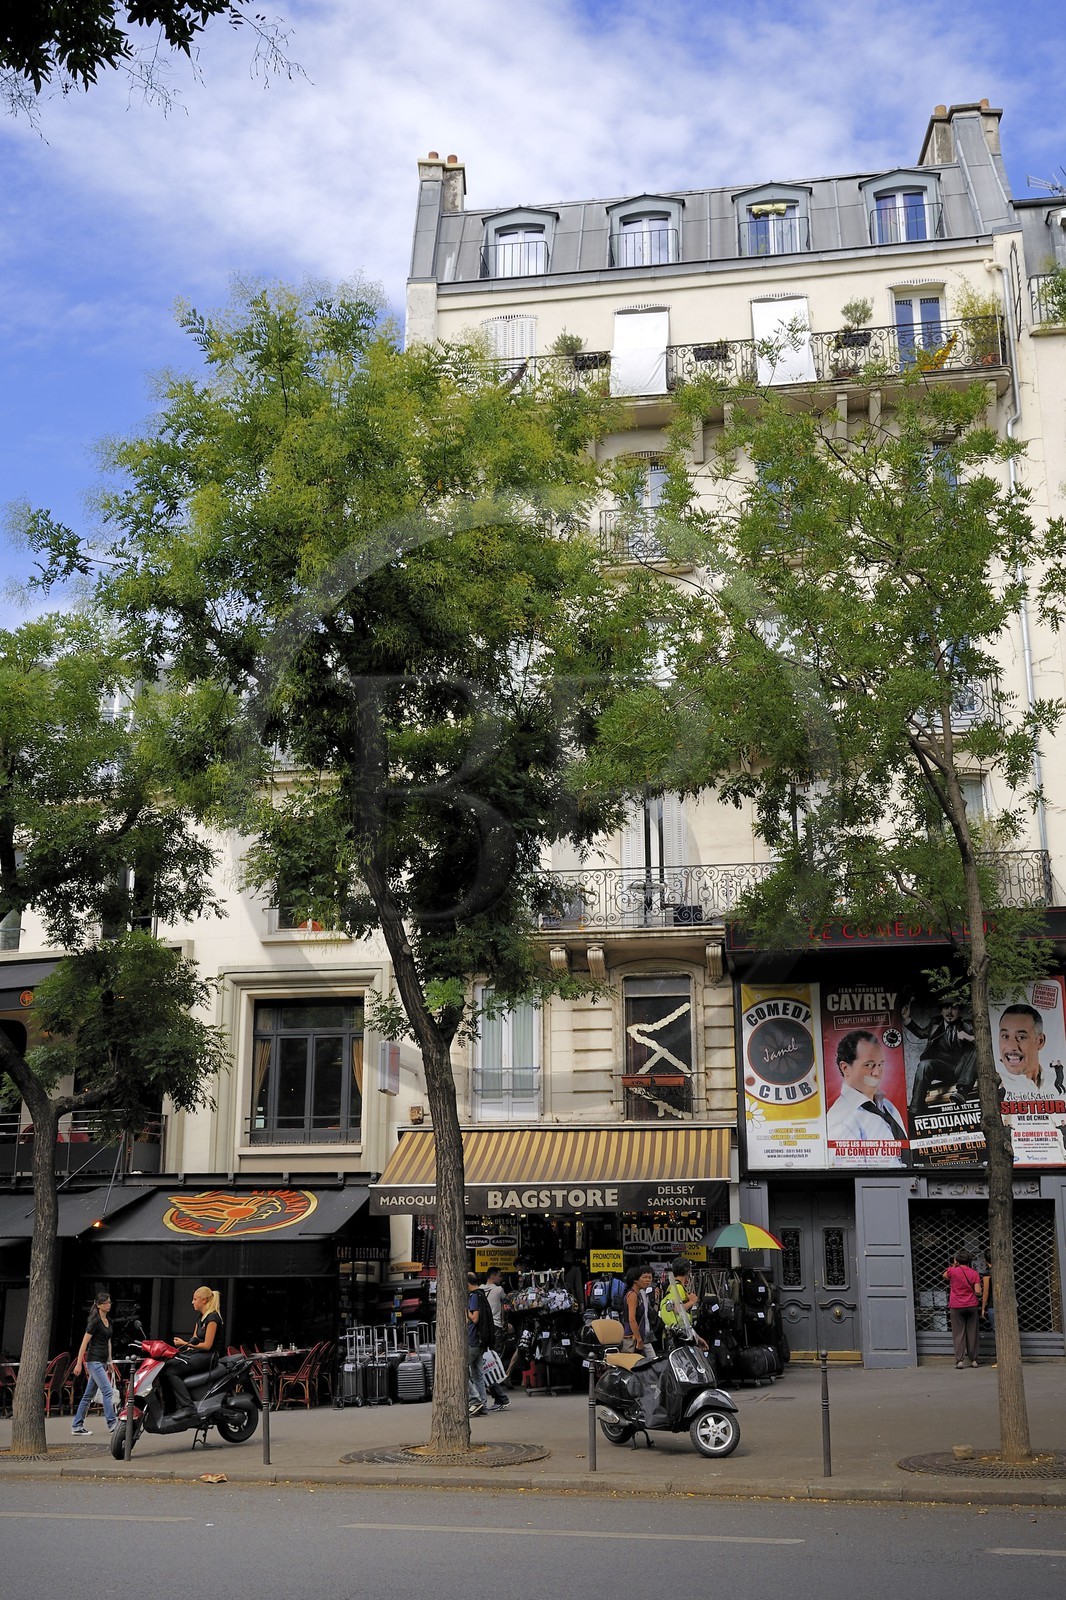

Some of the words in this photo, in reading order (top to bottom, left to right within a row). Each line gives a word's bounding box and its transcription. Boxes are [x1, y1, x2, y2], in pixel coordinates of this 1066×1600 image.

[826, 992, 898, 1012] CAYREY
[746, 1002, 811, 1027] COMEDY
[763, 1037, 799, 1063] Jamel
[759, 1081, 812, 1101] CLUB
[1000, 1100, 1066, 1115] SECTEUR
[835, 1148, 846, 1156] AU
[847, 1148, 881, 1157] COMEDY
[881, 1148, 902, 1156] CLUB
[931, 1142, 963, 1153] COMEDY
[965, 1140, 987, 1150] CLUB
[487, 1188, 619, 1210] BAGSTORE
[657, 1185, 696, 1195] DELSEY
[647, 1196, 707, 1207] SAMSONITE
[622, 1227, 704, 1242] PROMOTIONS
